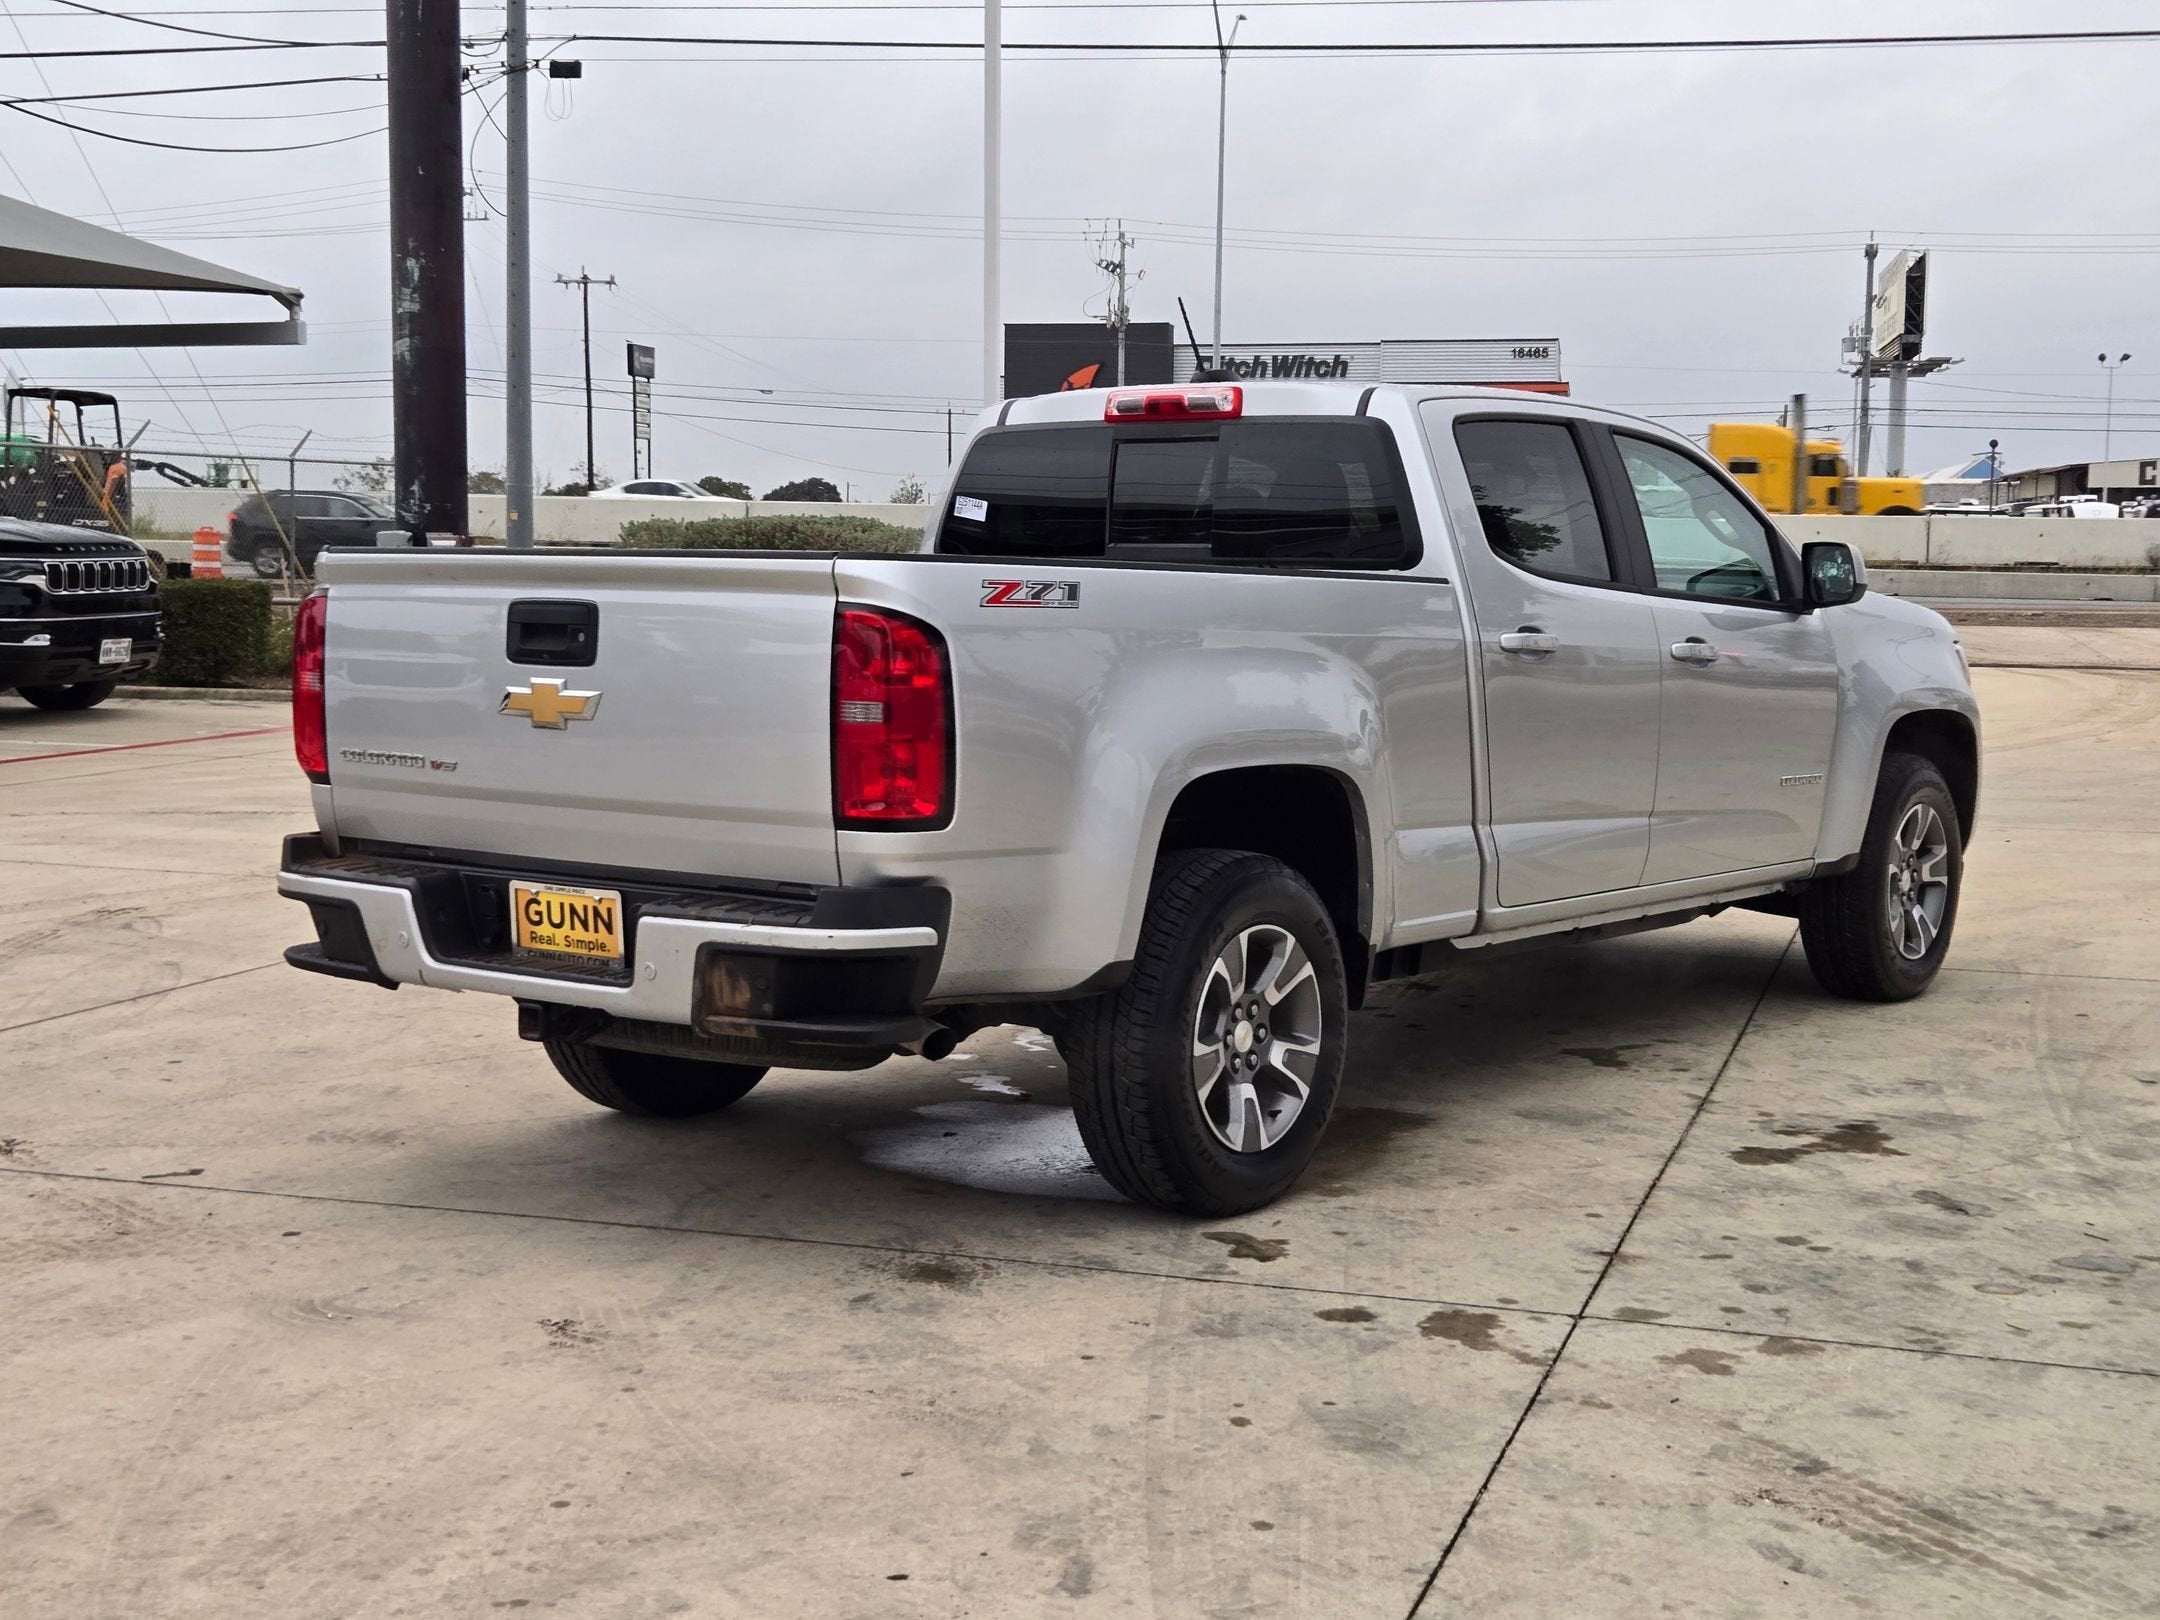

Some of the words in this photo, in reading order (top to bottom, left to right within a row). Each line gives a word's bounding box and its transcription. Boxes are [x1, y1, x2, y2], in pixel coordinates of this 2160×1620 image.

[1511, 347, 1549, 359] 16465
[1271, 354, 1349, 378] Witch
[980, 579, 1080, 608] Z71
[524, 897, 614, 936] GUNN
[529, 930, 560, 947] Real.
[563, 934, 611, 953] Simple.
